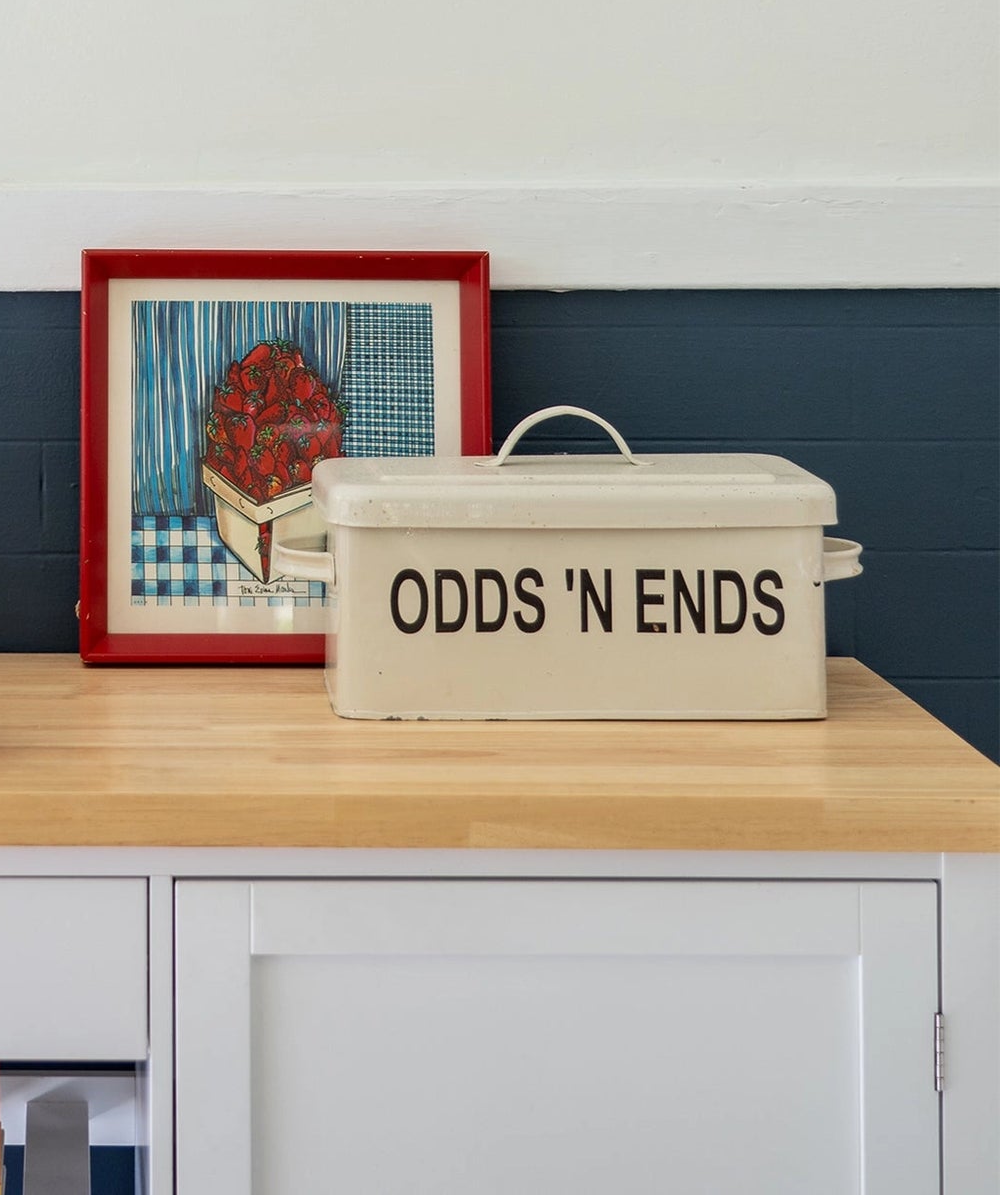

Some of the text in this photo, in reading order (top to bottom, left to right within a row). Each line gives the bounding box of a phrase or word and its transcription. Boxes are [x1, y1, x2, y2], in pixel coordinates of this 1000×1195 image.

[390, 567, 785, 636] ODDS 'N ENDS
